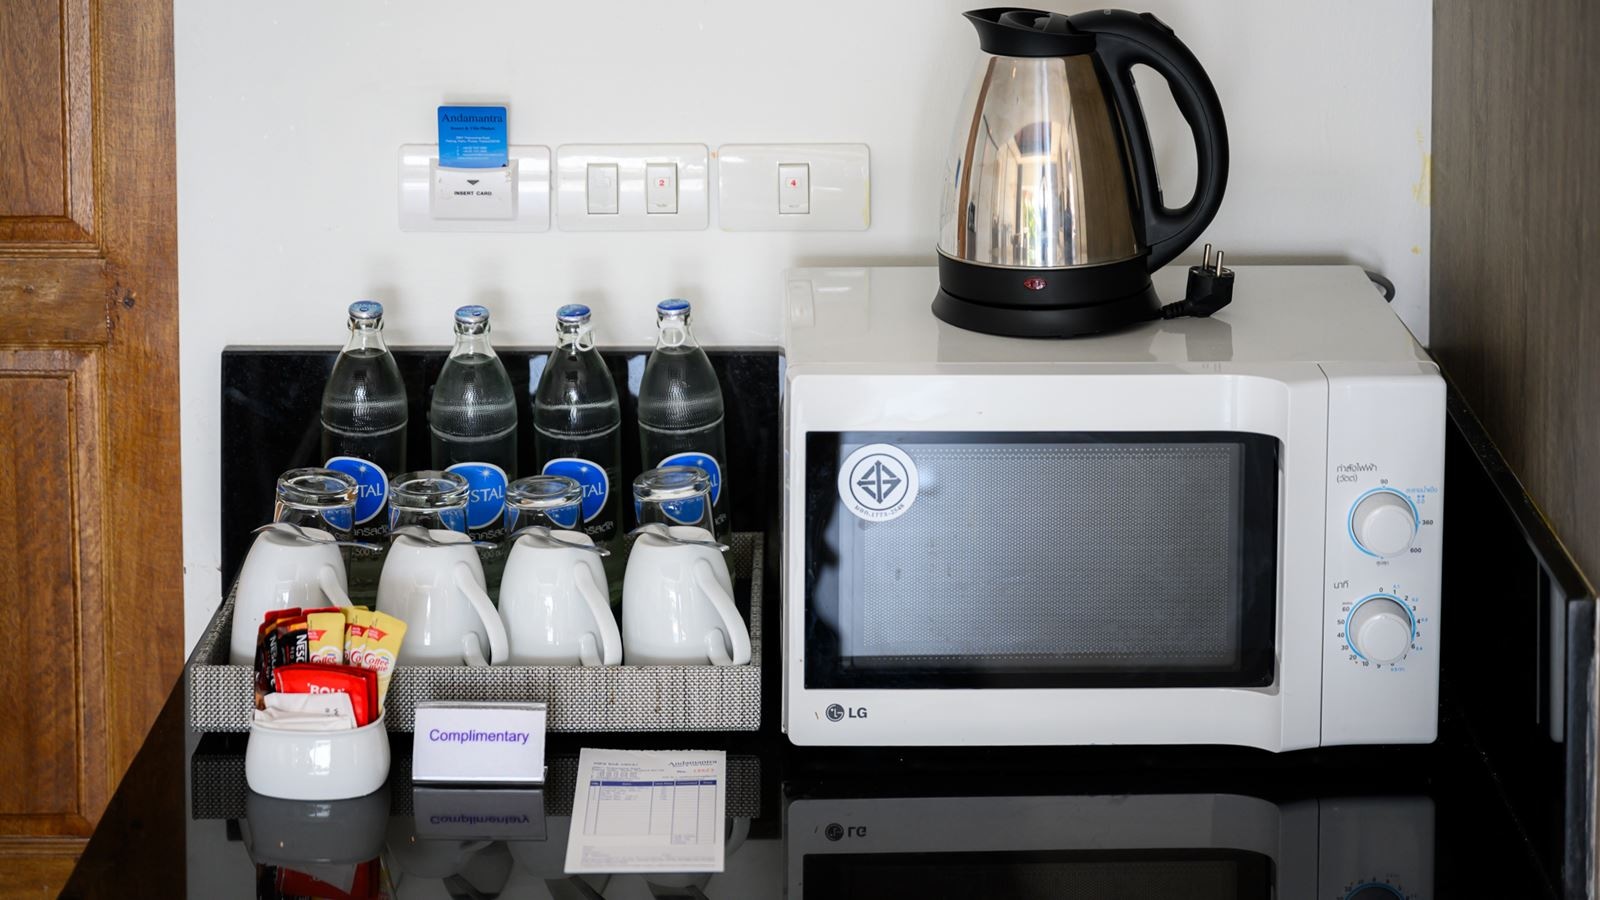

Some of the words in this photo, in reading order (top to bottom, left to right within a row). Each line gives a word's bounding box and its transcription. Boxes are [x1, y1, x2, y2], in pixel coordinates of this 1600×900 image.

[442, 112, 503, 122] Andamantra
[357, 483, 383, 498] TAL
[469, 485, 505, 503] STAL
[581, 482, 604, 498] TAL
[296, 634, 307, 665] NESC
[848, 707, 868, 718] LG
[429, 729, 530, 745] Complimentary
